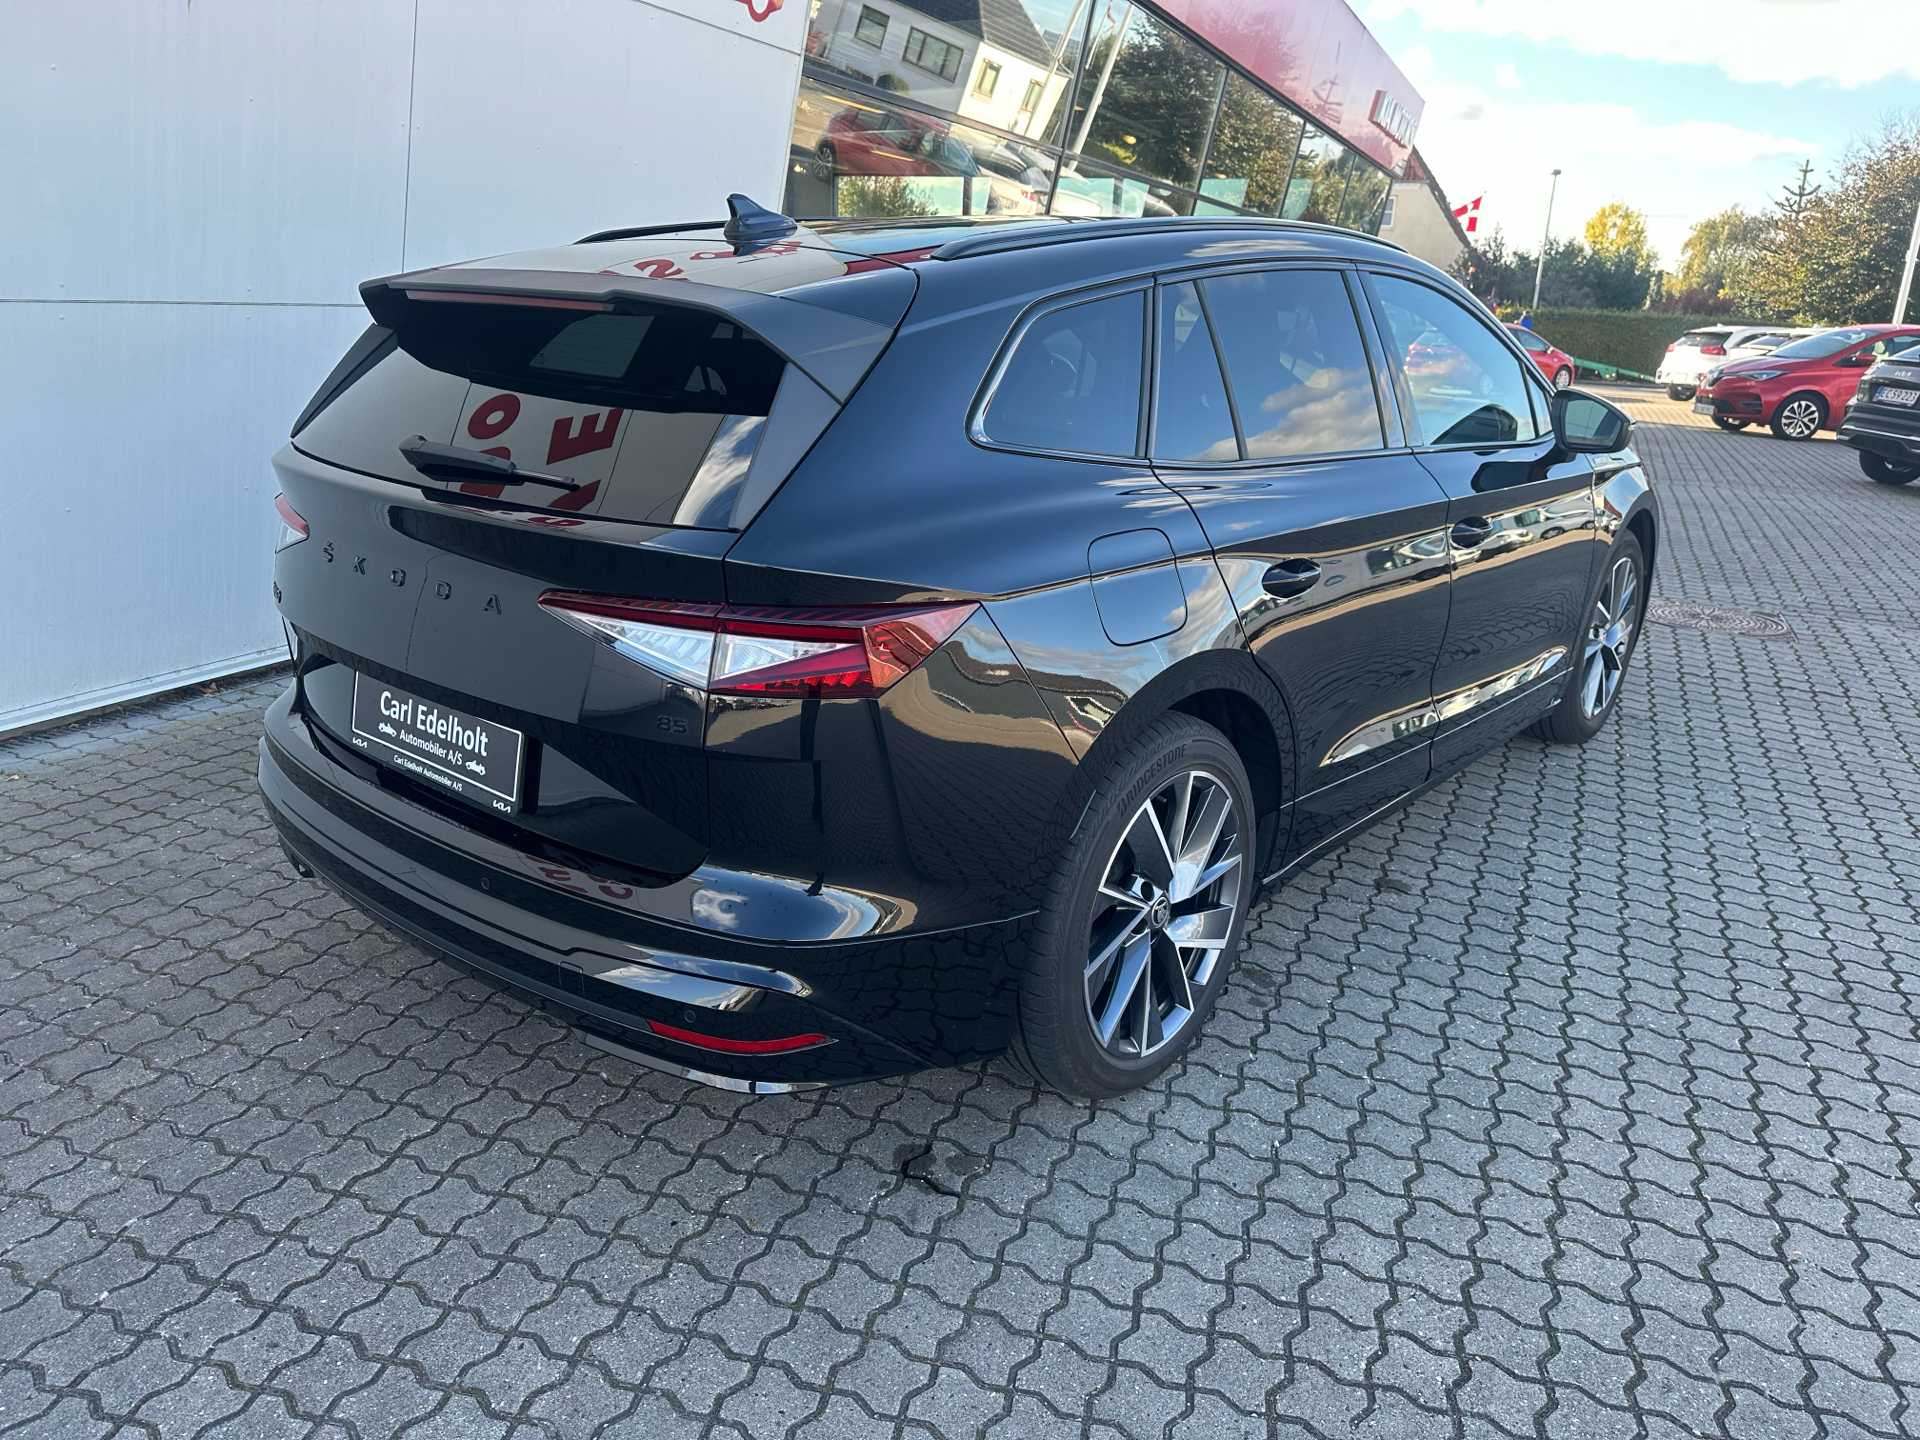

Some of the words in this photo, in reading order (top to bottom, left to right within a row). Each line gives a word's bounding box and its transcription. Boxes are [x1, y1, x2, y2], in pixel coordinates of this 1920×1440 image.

[380, 690, 413, 725] Carl
[416, 704, 488, 757] Edelholt
[656, 715, 688, 734] 85
[399, 729, 447, 758] Automobiler
[447, 749, 463, 766] A/S
[393, 754, 404, 765] Carl
[403, 758, 423, 775] Edelholt
[452, 781, 463, 792] A/S
[1116, 743, 1188, 818] BRIDGESTONE
